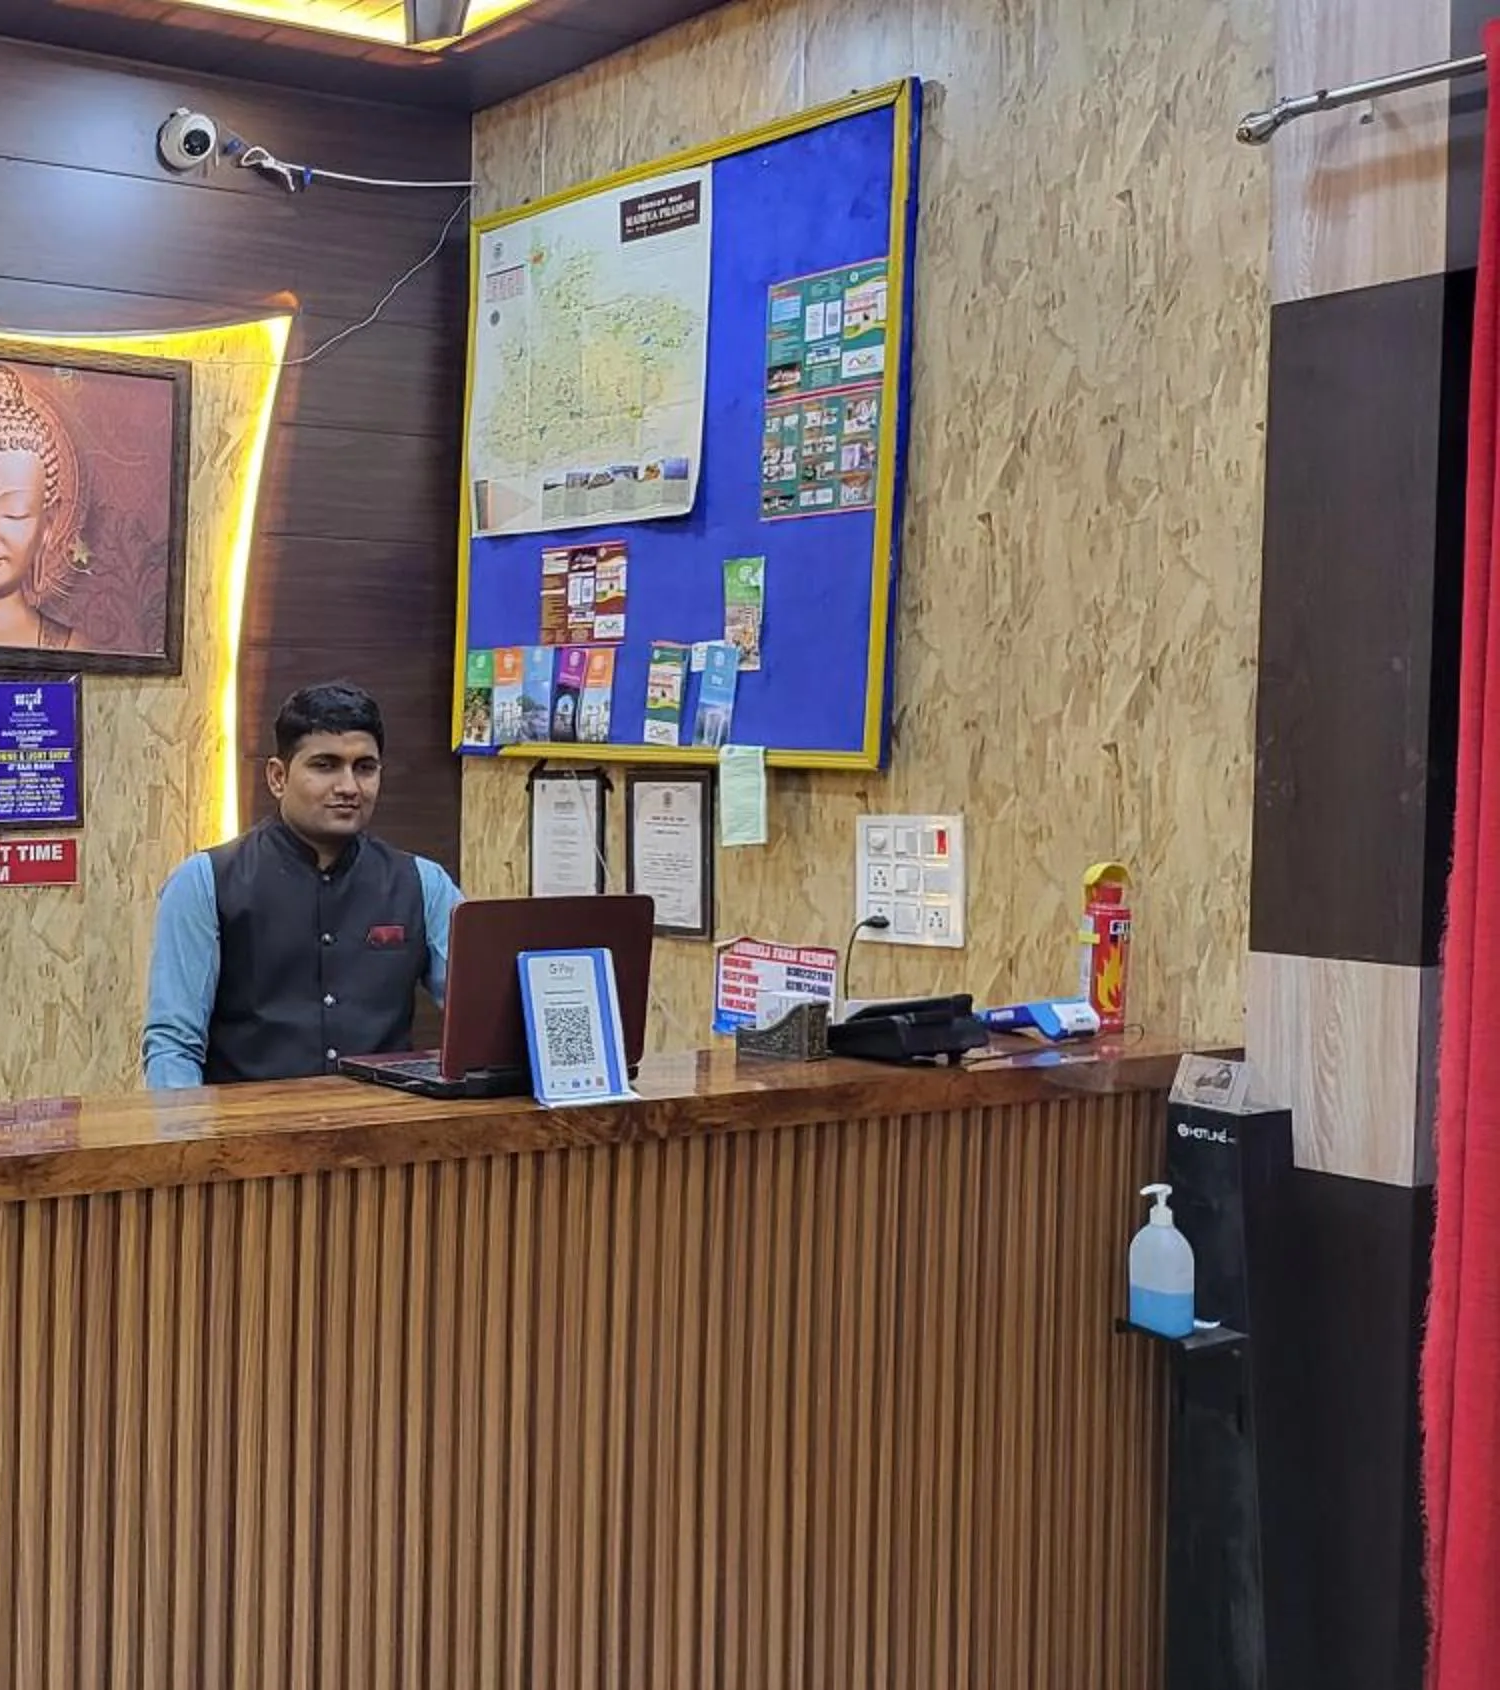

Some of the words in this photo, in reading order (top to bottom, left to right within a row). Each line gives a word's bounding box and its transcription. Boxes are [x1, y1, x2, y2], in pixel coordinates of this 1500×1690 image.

[625, 210, 658, 227] MADHYA
[660, 199, 695, 218] PRADESH
[16, 843, 63, 862] TIME
